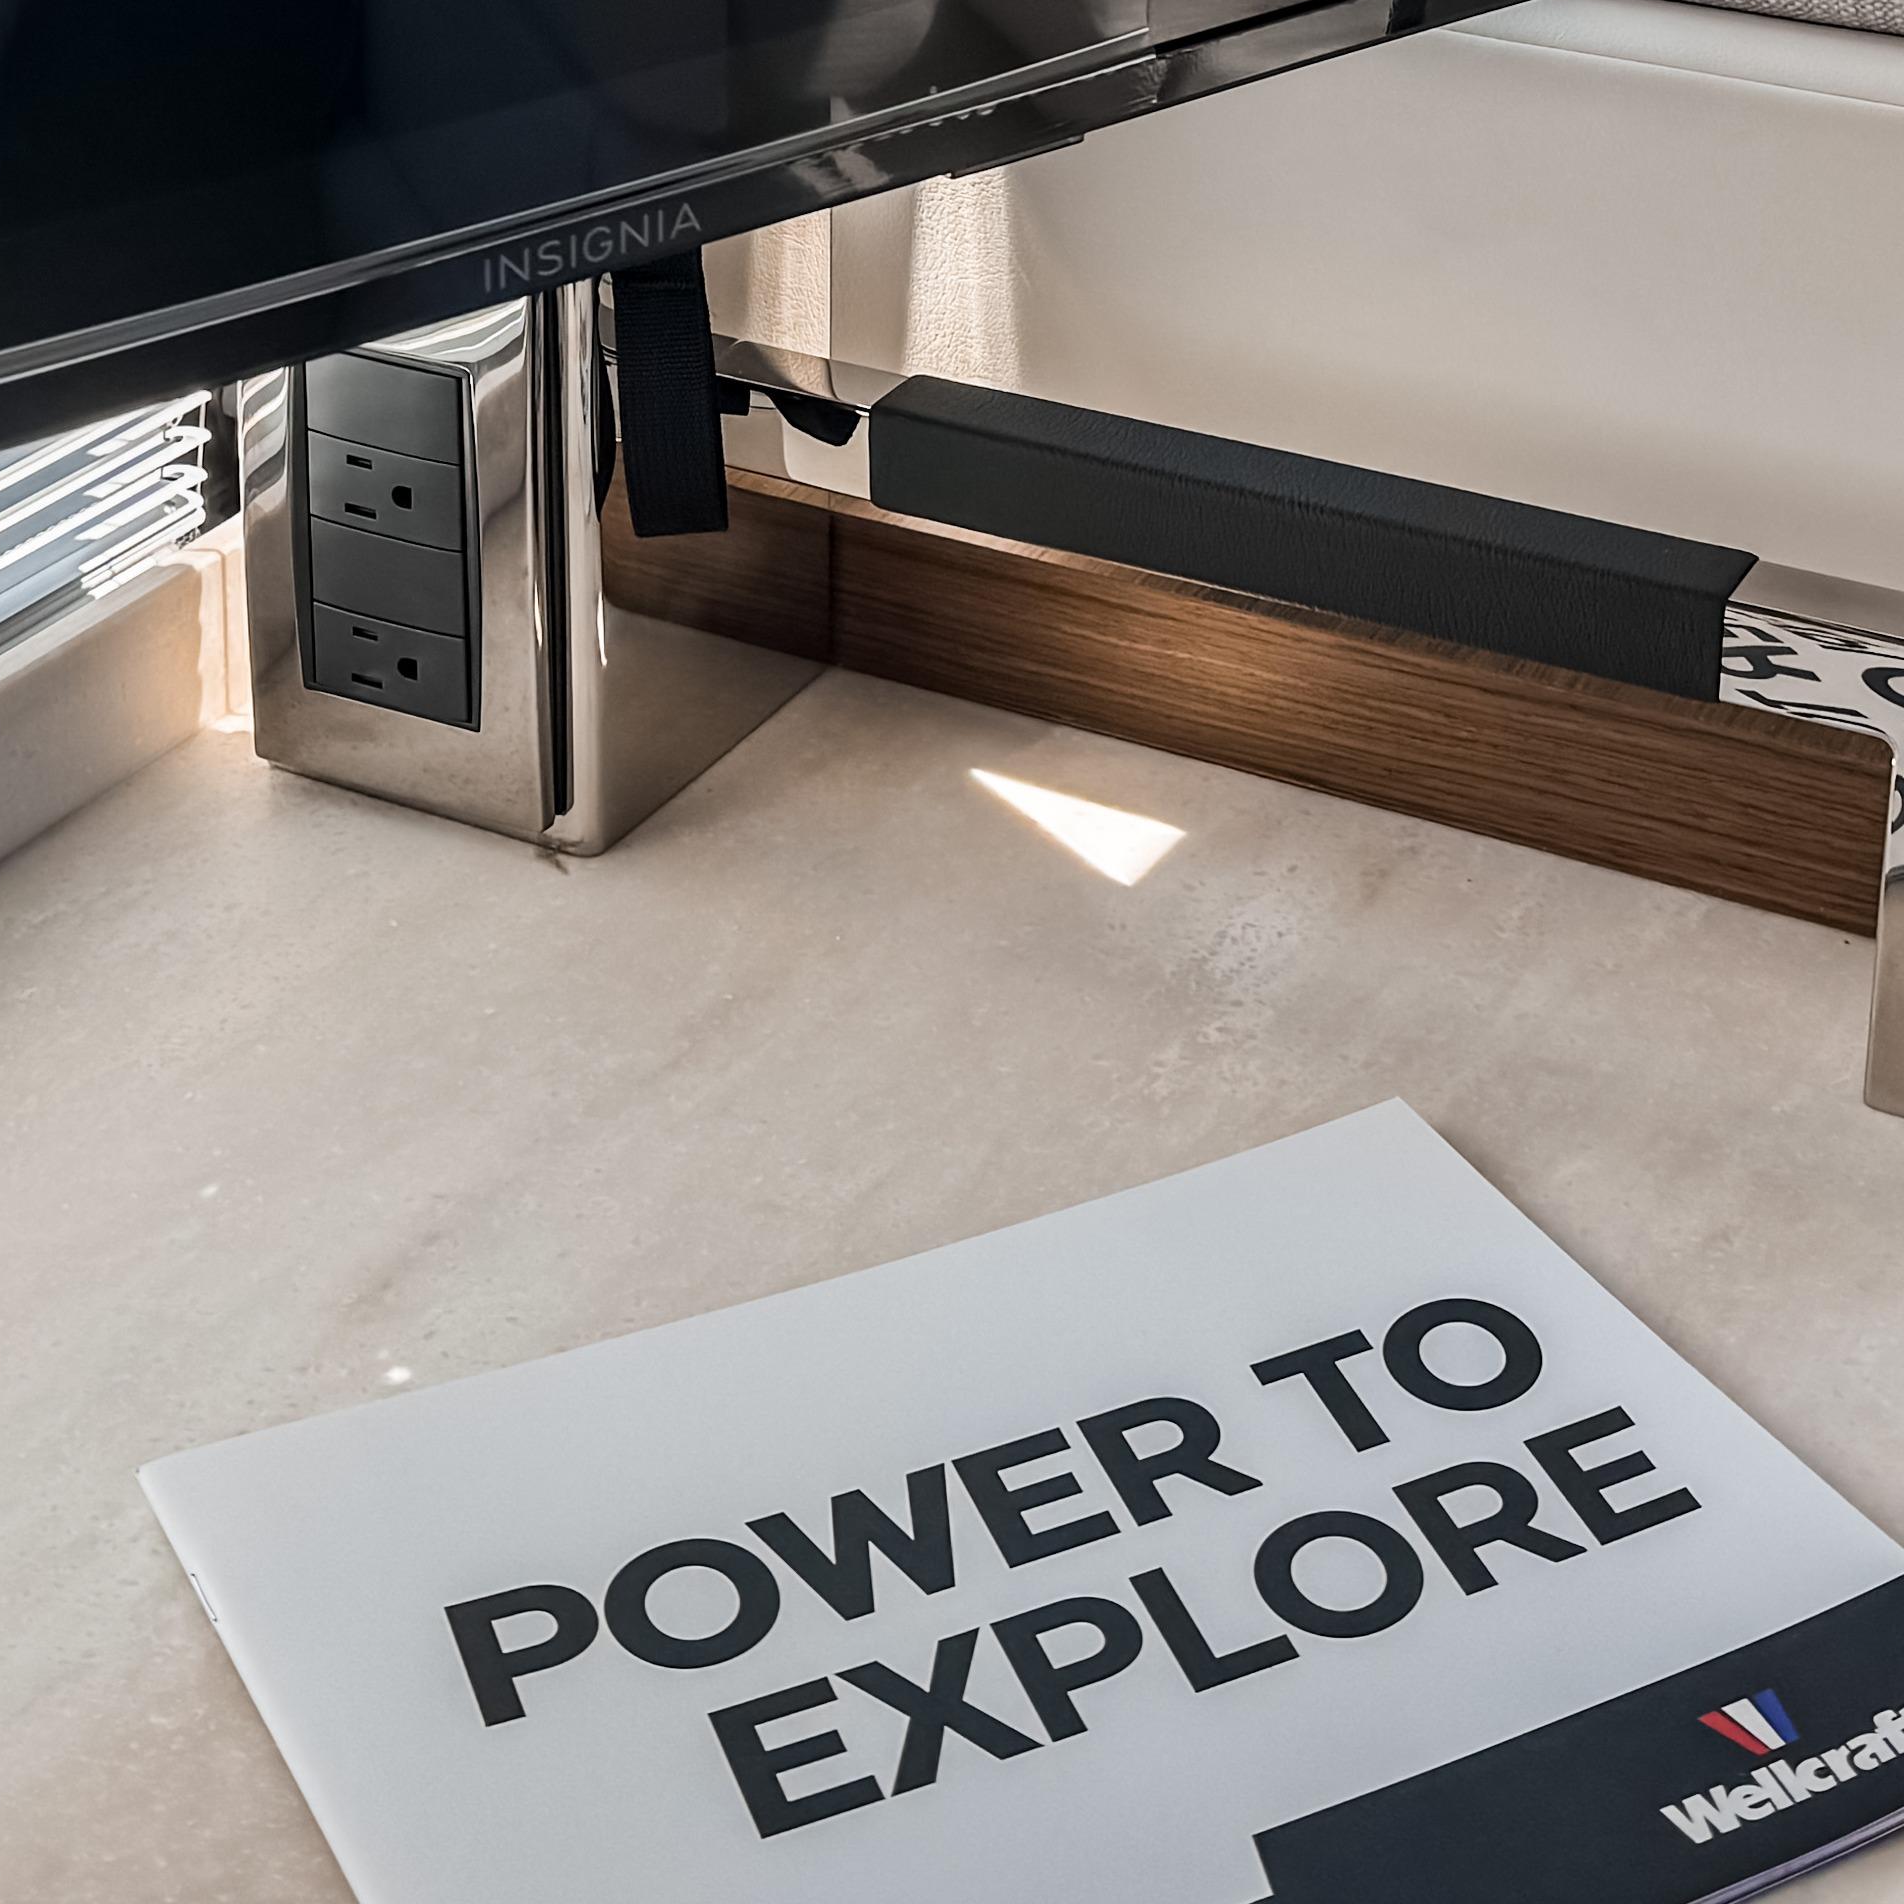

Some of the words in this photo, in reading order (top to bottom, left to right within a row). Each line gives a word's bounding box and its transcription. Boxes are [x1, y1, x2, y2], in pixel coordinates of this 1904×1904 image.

[484, 203, 701, 293] INSIGNIA
[443, 1397, 1264, 1727] POWER
[1249, 1298, 1543, 1453] TO
[707, 1405, 1702, 1839] EXPLORE
